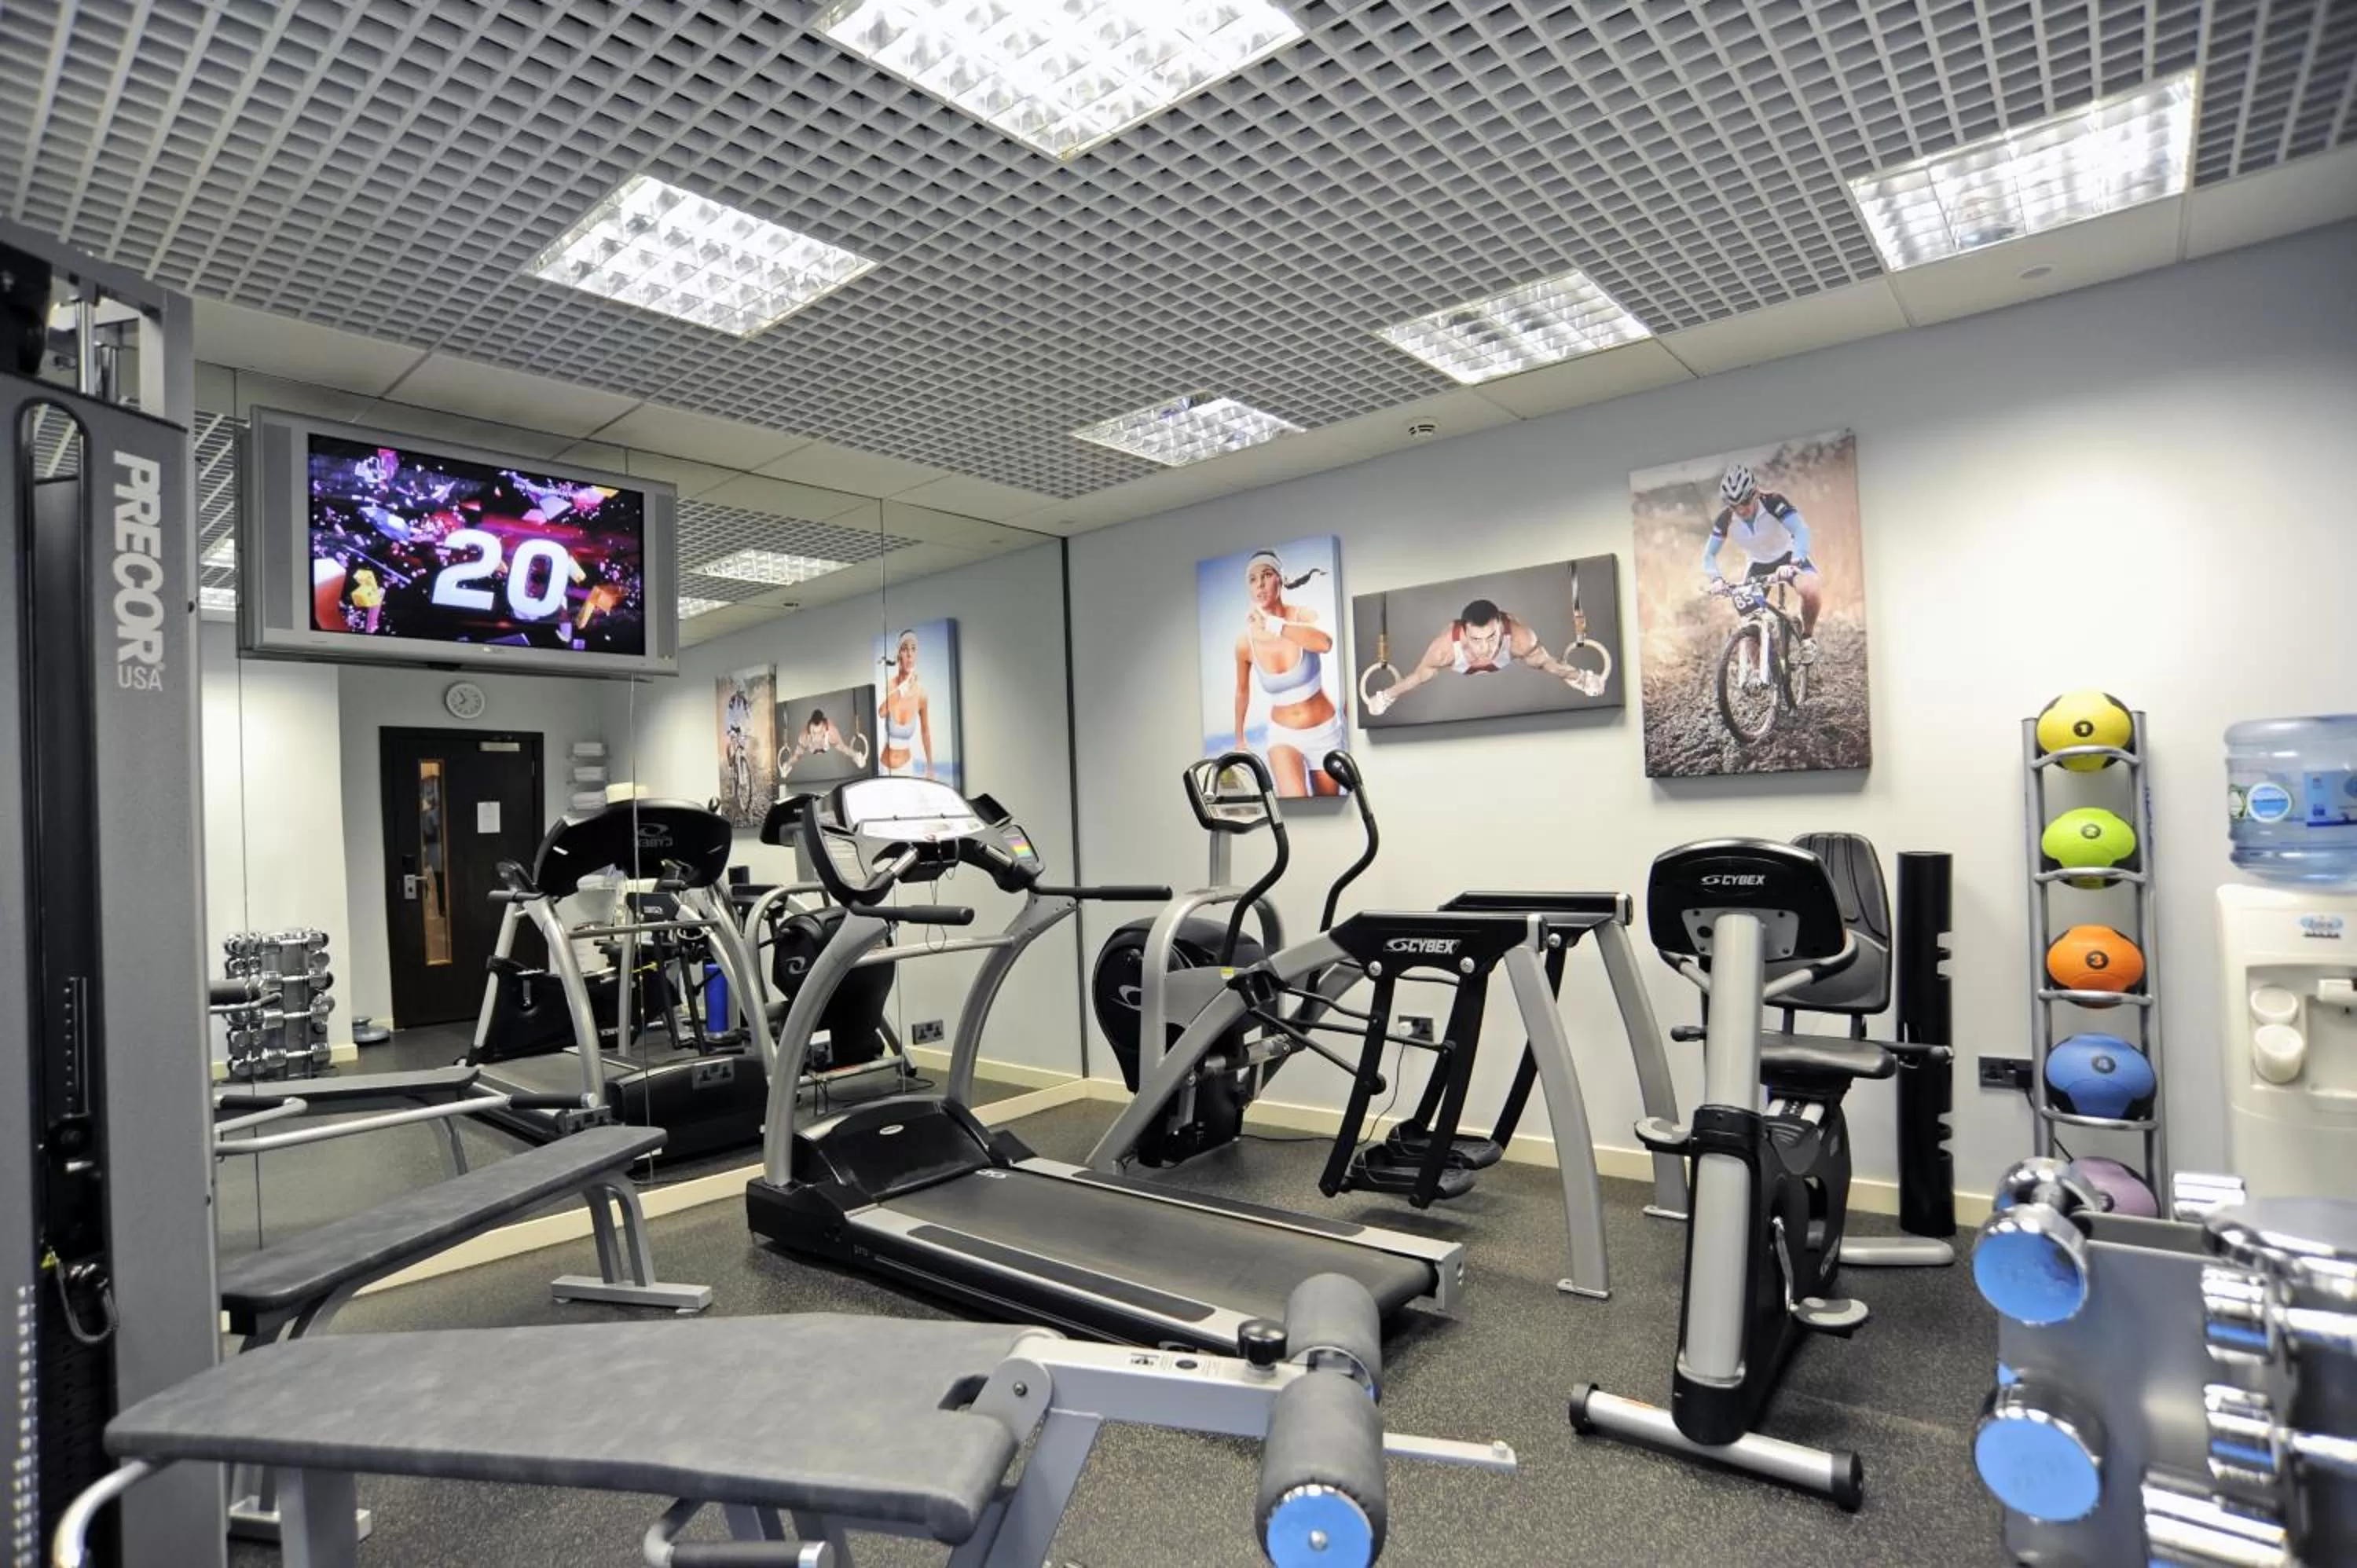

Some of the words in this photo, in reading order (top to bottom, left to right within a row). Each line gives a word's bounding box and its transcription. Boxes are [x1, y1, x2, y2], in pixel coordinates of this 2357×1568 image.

[113, 450, 163, 664] PRECOR
[432, 529, 570, 621] 20
[118, 664, 163, 691] USA
[1721, 874, 1765, 885] CYBEX
[1407, 938, 1453, 954] CYBEX
